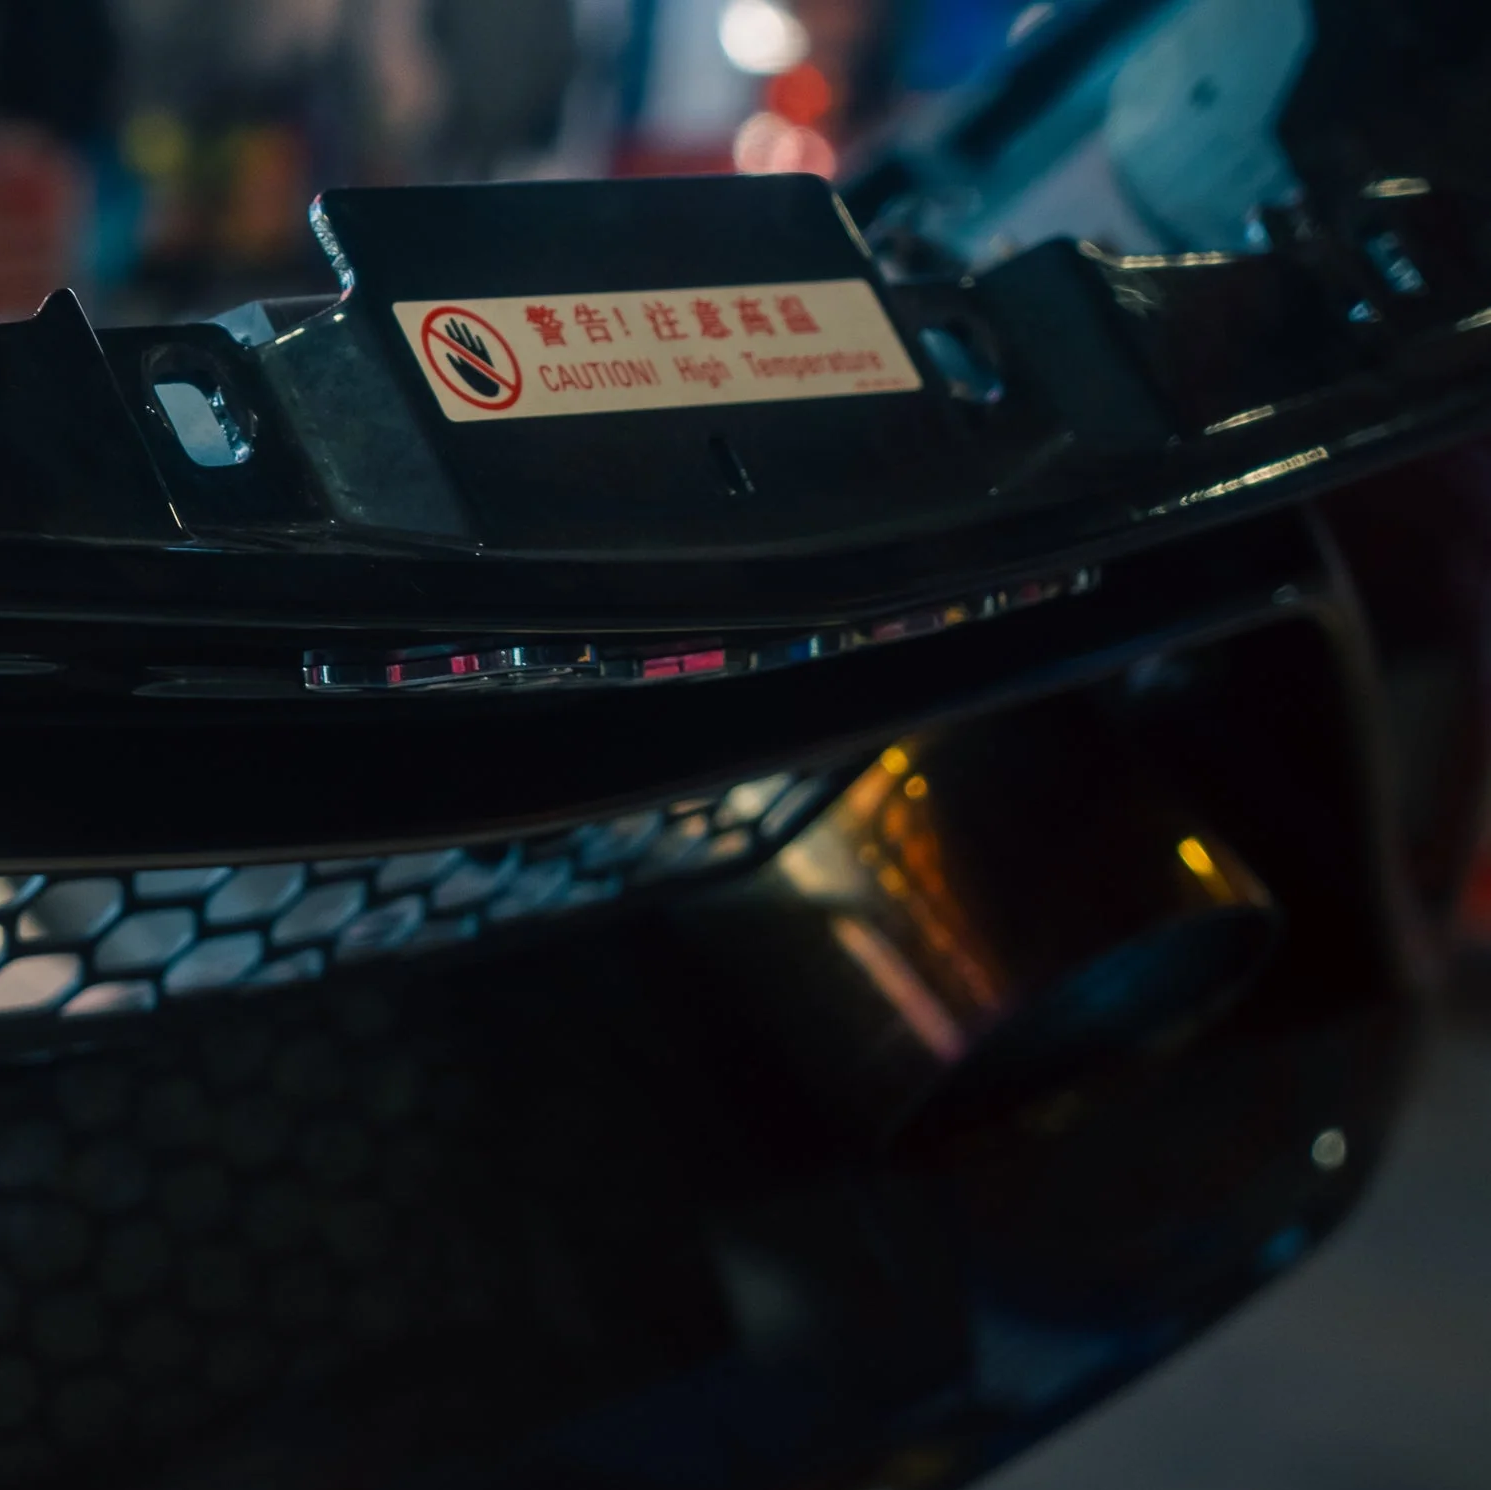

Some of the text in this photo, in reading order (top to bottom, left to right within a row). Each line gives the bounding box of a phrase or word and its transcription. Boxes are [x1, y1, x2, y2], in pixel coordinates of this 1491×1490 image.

[538, 350, 883, 393] CAUTION! High Temperature
